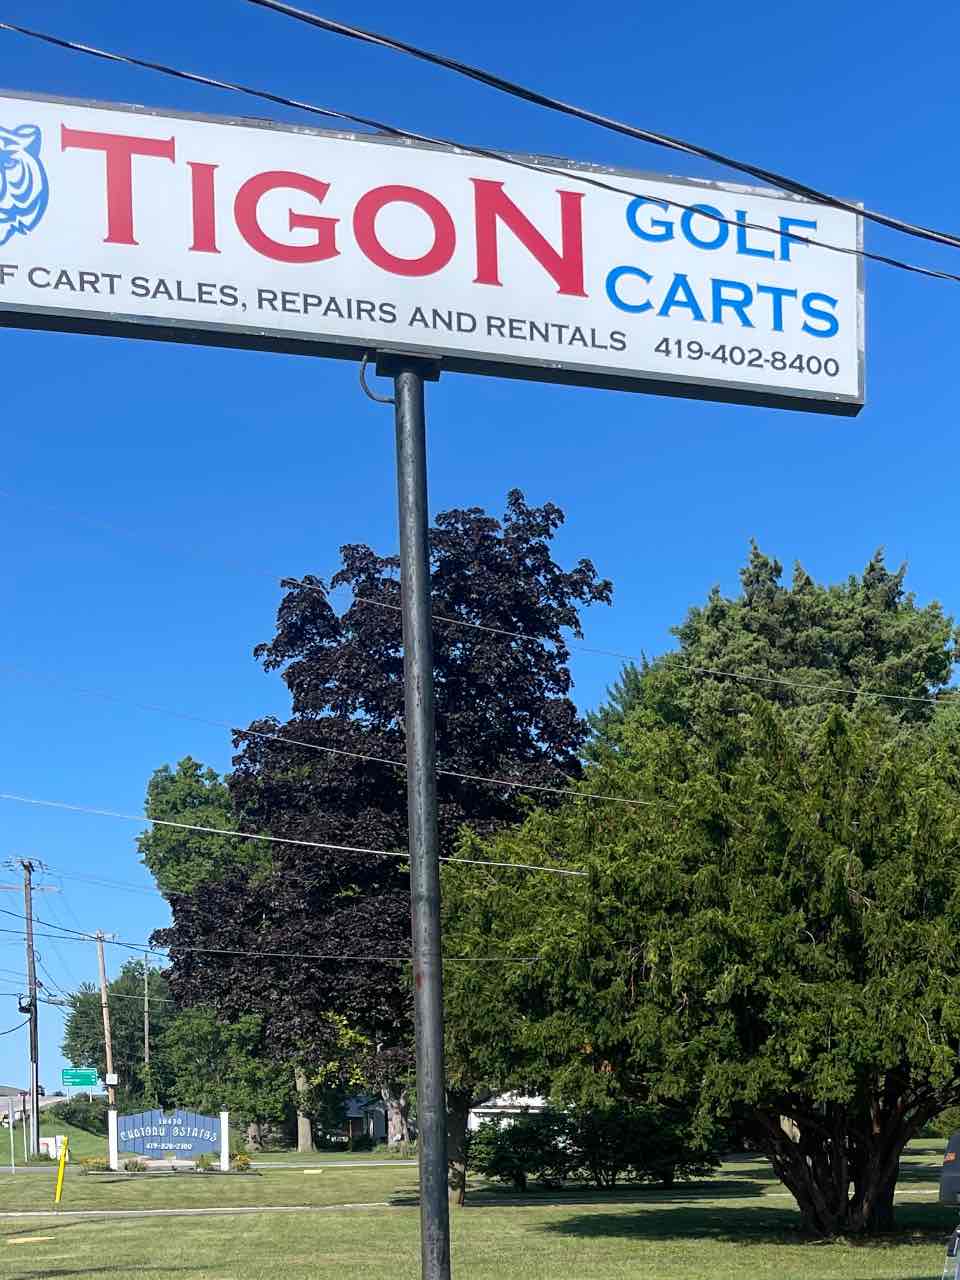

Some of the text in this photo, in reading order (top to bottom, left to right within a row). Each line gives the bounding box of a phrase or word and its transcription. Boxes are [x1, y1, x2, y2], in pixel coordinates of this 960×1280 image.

[60, 122, 589, 297] TIGON
[625, 195, 817, 262] GOLF
[28, 266, 122, 296] CART
[131, 276, 248, 312] SALES,
[257, 288, 398, 323] REPAIRS
[408, 306, 477, 333] AND
[486, 315, 627, 352] RENTALS
[604, 264, 840, 338] CARTS
[654, 336, 840, 377] 419-402-8400
